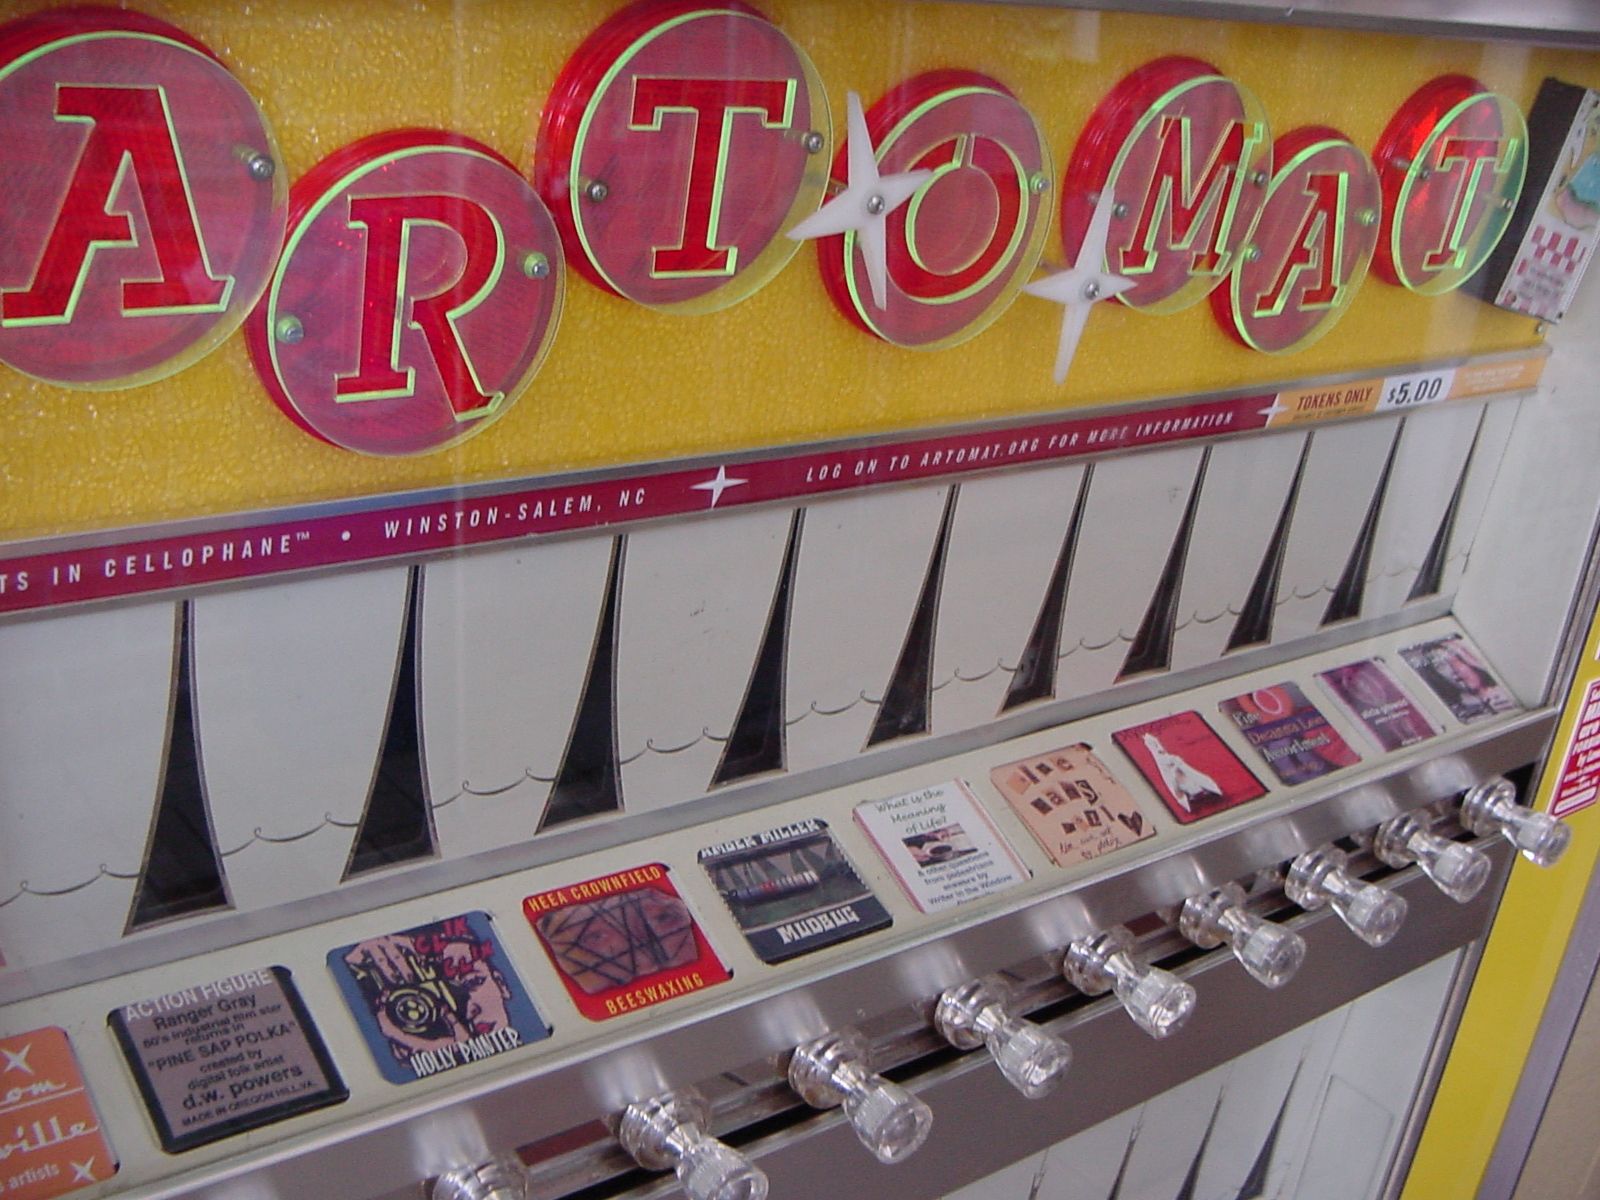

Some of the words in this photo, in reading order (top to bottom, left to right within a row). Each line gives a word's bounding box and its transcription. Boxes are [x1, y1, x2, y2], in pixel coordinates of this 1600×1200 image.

[1297, 391, 1342, 411] TOKENS
[1344, 386, 1373, 405] ONLY
[1387, 377, 1443, 405] $5.00
[806, 463, 842, 482] LOG
[854, 460, 878, 476] ON
[889, 454, 909, 471] TO
[920, 438, 1039, 466] ARTOMAT.ORG
[1048, 432, 1079, 449] FOR
[1087, 426, 1129, 443] MORE
[1135, 411, 1234, 437] INFORMATION
[53, 564, 80, 585] IN
[384, 494, 602, 539] WINSTON-SALEM,
[619, 488, 645, 507] NC
[874, 798, 909, 813] What
[910, 793, 922, 804] is
[923, 788, 944, 800] the
[890, 803, 946, 824] Meaning
[759, 819, 820, 845] MILLER
[904, 825, 917, 835] of
[920, 815, 947, 832] Life?
[570, 865, 661, 900] CROWNFIELD
[776, 905, 860, 945] MUDBUG
[126, 987, 199, 1022] ACTION
[200, 968, 273, 999] FIGURE
[605, 972, 704, 1015] BEESWAXING
[153, 1003, 213, 1031] Ranger
[217, 993, 257, 1014] Gray
[232, 1023, 245, 1033] in
[199, 1038, 231, 1059] SAP
[199, 1053, 245, 1073] created
[249, 1048, 263, 1061] by
[410, 1043, 458, 1077] HOLLY
[458, 1027, 523, 1064] PAINTER
[182, 1090, 224, 1110] d.w.
[228, 1065, 303, 1099] powers
[187, 1072, 227, 1092] digital
[228, 1065, 252, 1081] folk
[253, 1054, 285, 1072] artist
[9, 1163, 60, 1190] artists
